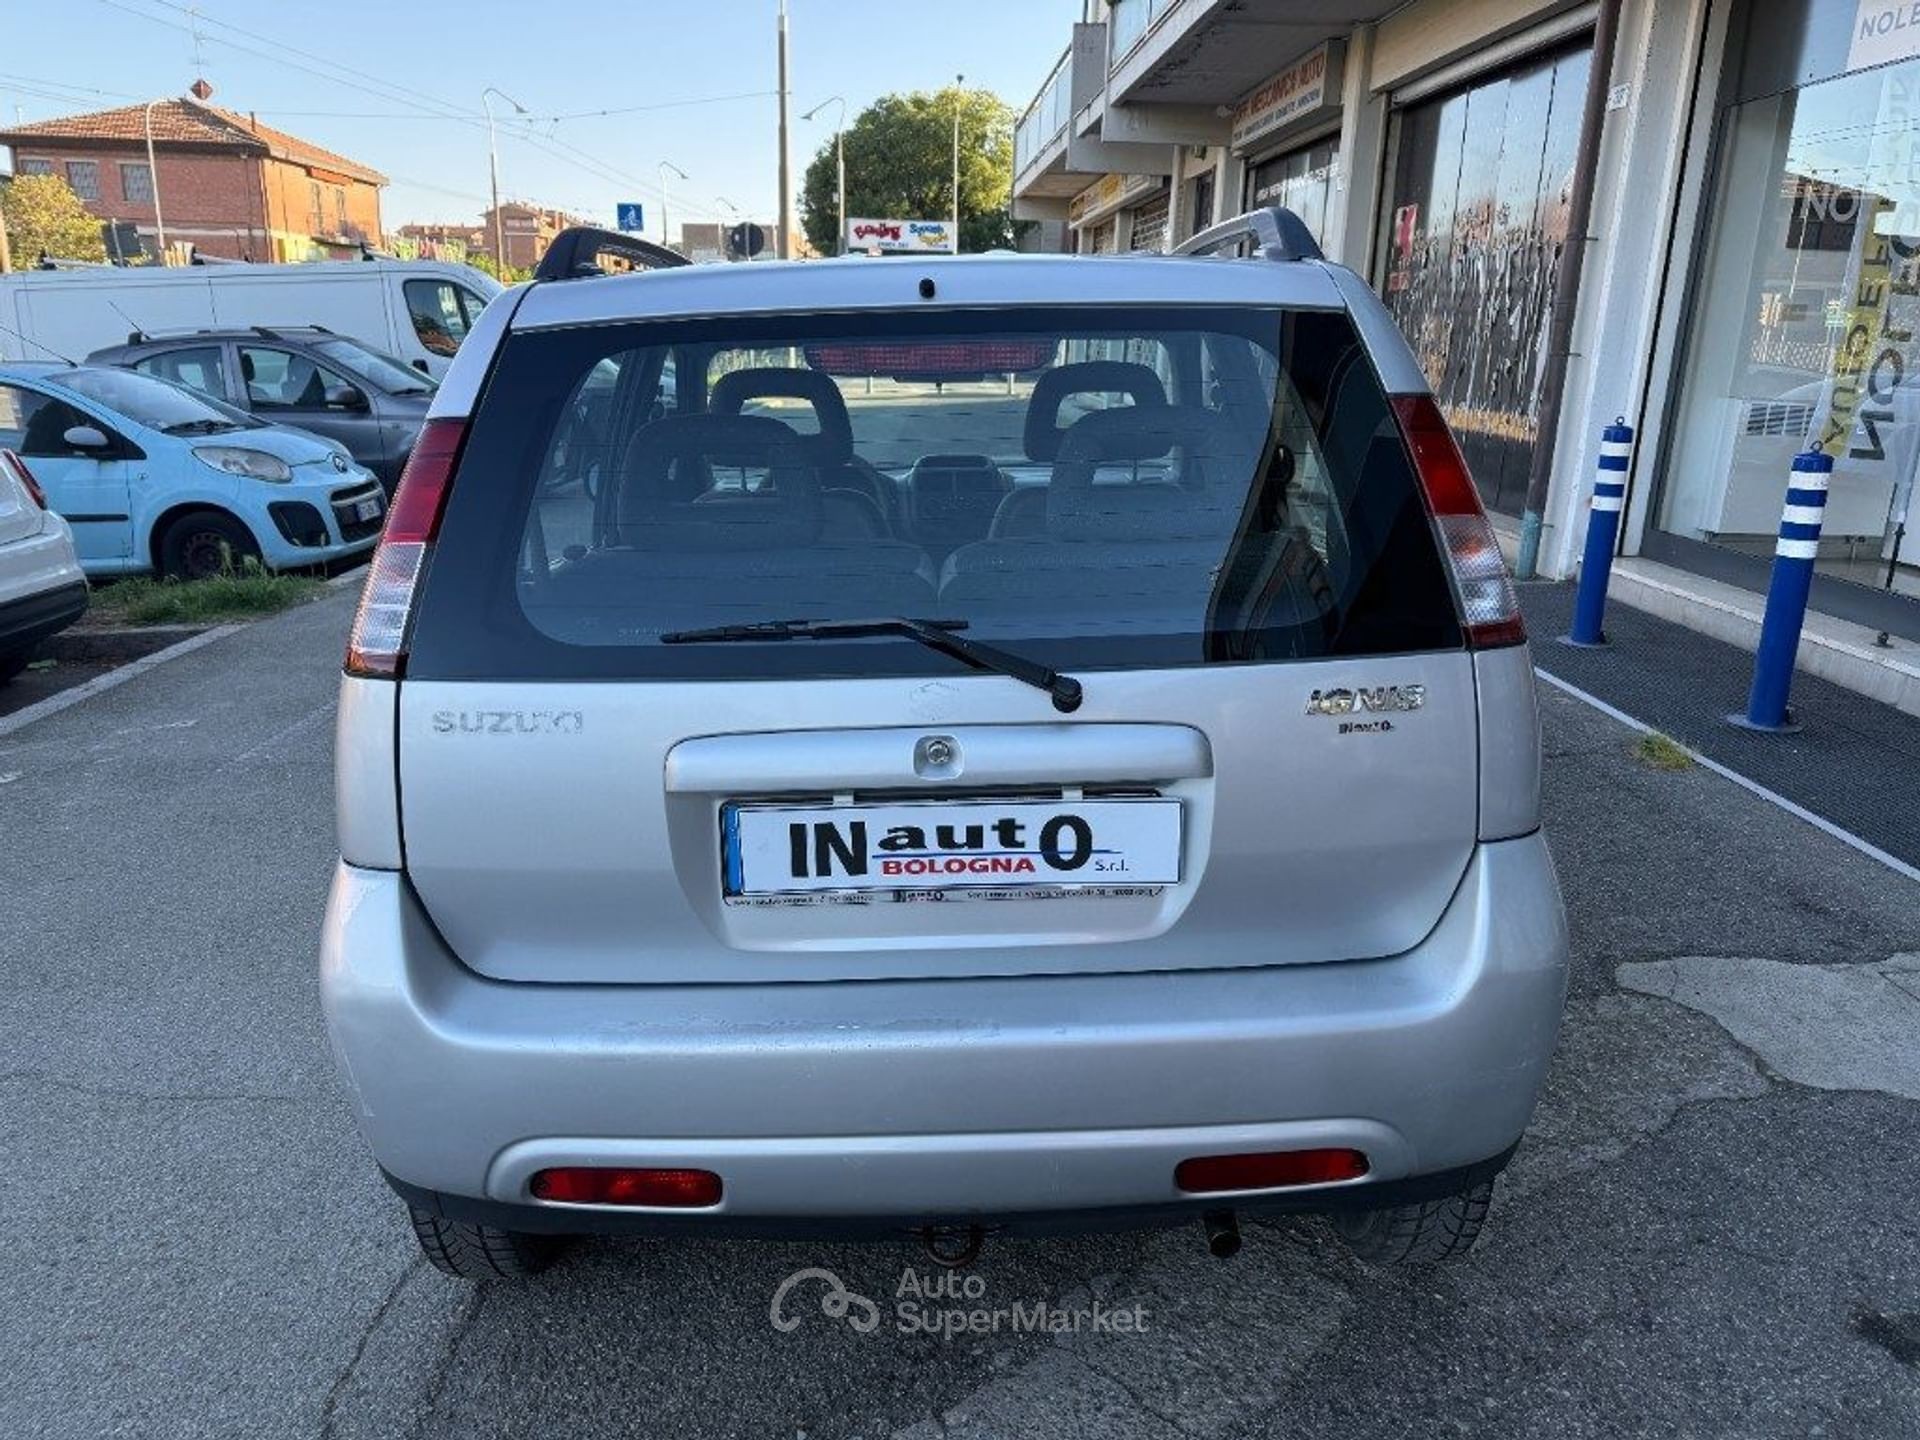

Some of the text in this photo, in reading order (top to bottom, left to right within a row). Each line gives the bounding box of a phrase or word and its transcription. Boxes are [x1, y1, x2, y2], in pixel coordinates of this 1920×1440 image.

[1299, 52, 1324, 87] AUTO
[432, 710, 583, 734] SUZUKI
[881, 857, 1036, 876] BOLOGNA
[1095, 859, 1130, 873] S.r.l.
